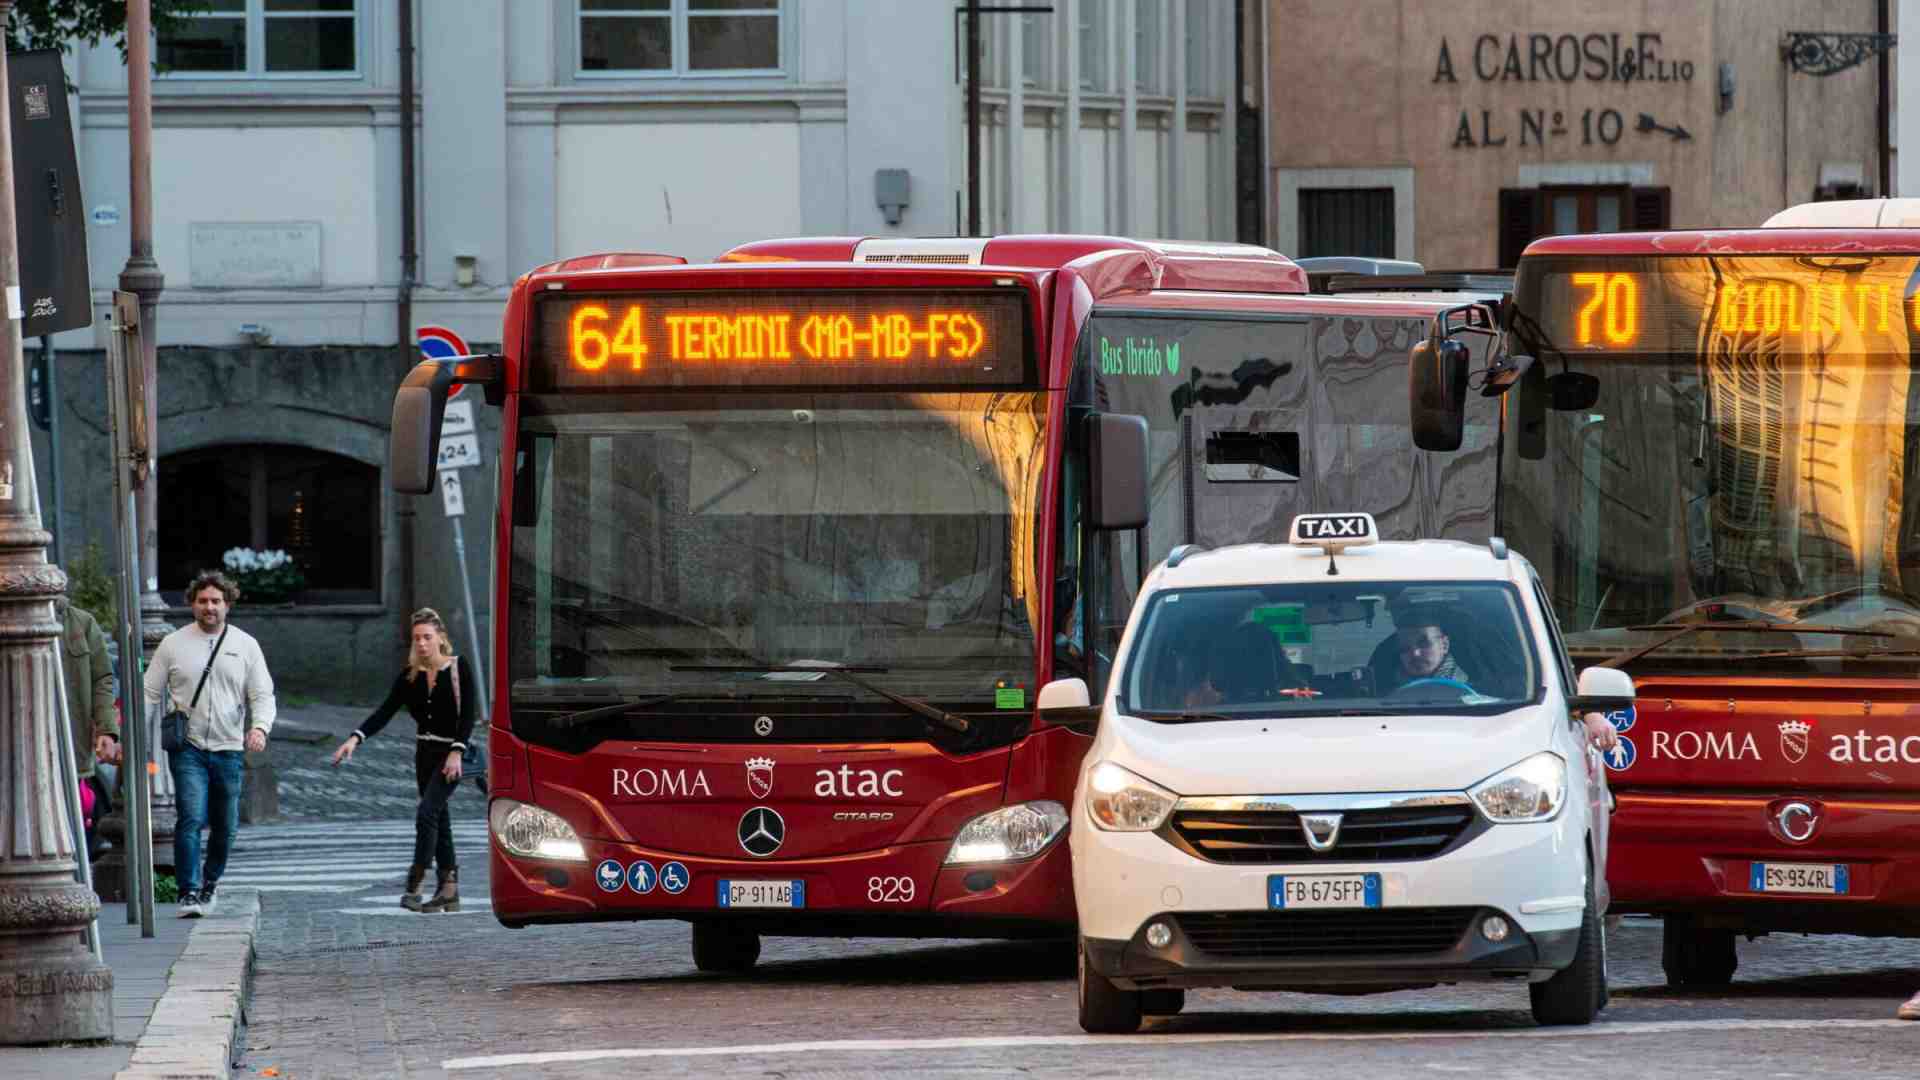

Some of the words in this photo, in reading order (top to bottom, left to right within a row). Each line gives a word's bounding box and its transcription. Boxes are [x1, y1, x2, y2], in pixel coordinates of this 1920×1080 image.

[1432, 34, 1457, 83] A
[1473, 33, 1620, 81] CAROSI
[1452, 109, 1506, 147] AL
[1581, 107, 1624, 146] 10
[1573, 272, 1635, 344] 70
[573, 306, 648, 370] 64
[665, 315, 791, 359] TERMINI
[1101, 337, 1123, 374] Bus
[1301, 518, 1364, 536] TAXI
[1651, 730, 1762, 760] ROMA
[1830, 729, 1920, 763] atac
[612, 768, 712, 796] ROMA
[814, 763, 904, 797] atac
[833, 812, 894, 820] CITARO
[867, 876, 916, 902] 829
